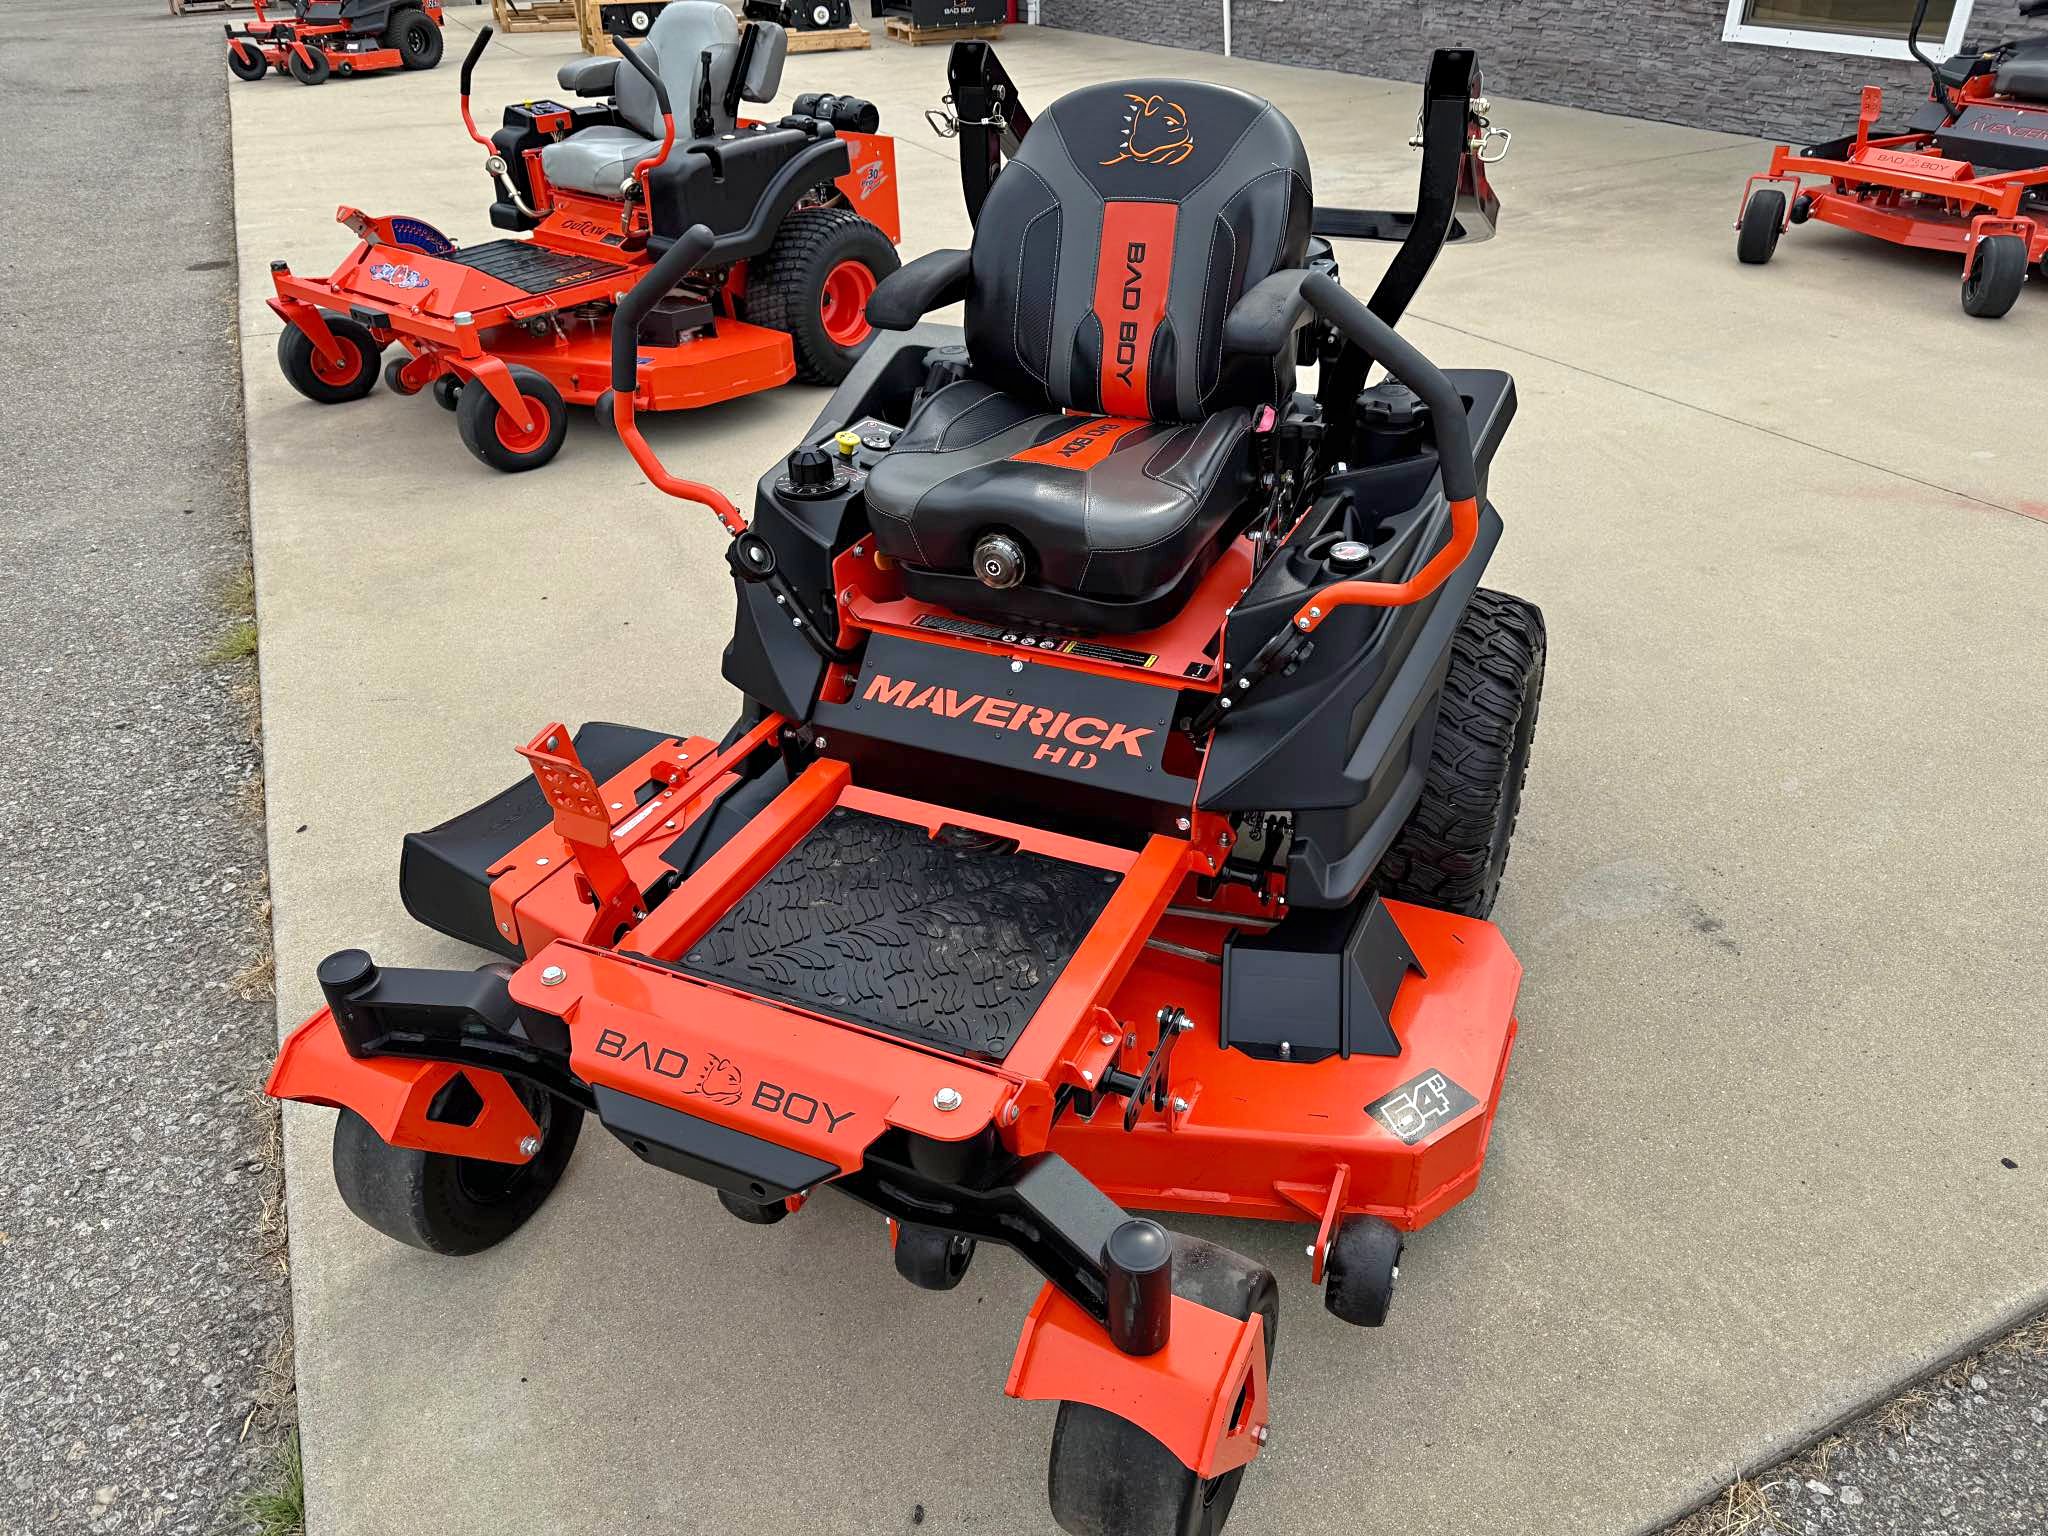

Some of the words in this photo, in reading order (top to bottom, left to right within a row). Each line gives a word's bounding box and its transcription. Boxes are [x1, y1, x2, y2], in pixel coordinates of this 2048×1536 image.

[943, 7, 959, 15] BAD
[960, 6, 976, 14] BOY
[1877, 154, 1905, 164] BAD
[1920, 161, 1949, 171] BOY
[1122, 241, 1146, 310] BAD
[1116, 321, 1138, 388] BOY
[1086, 423, 1121, 437] BAD
[1056, 437, 1094, 458] BOY
[862, 674, 1156, 757] MAVERICK
[1032, 743, 1098, 769] HD
[595, 1028, 689, 1079] BAD
[752, 1080, 856, 1134] BOY
